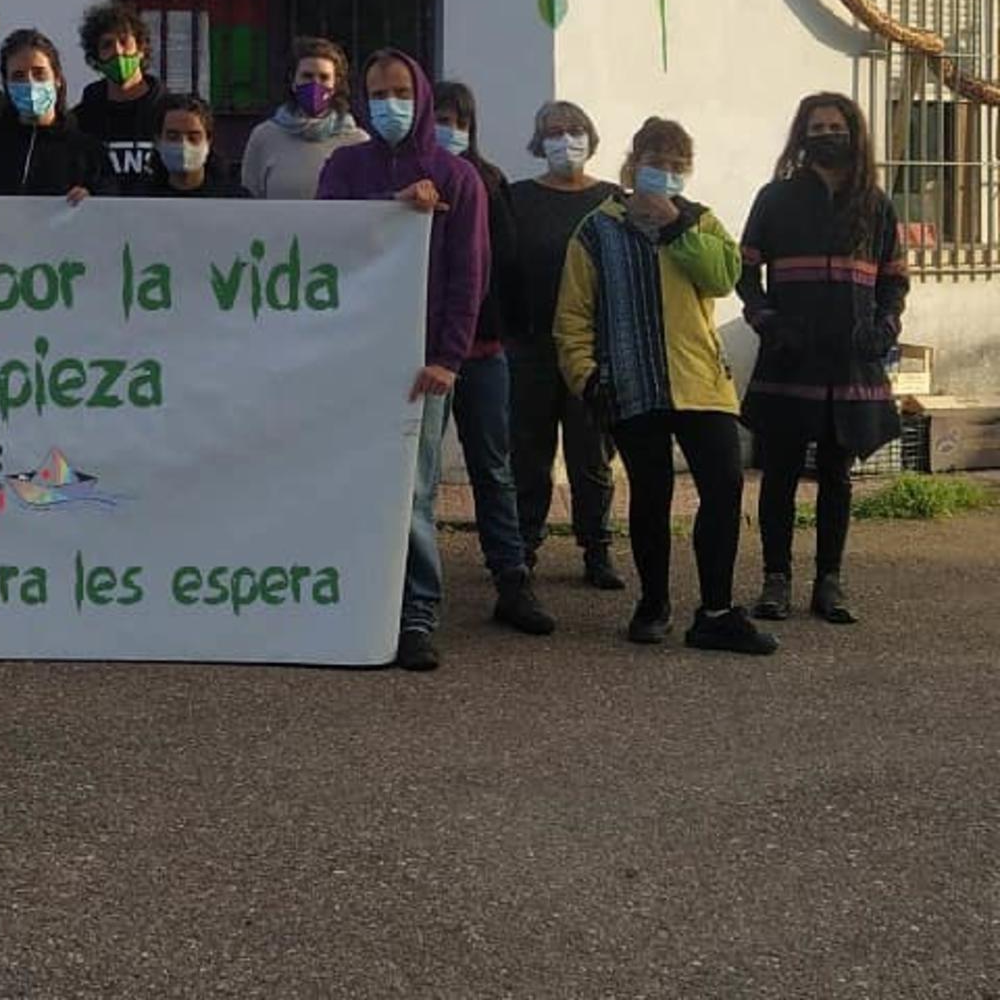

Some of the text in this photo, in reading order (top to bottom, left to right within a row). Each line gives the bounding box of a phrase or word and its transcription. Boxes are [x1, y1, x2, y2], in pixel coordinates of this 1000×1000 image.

[122, 241, 172, 319] la
[210, 237, 341, 319] vida
[74, 551, 144, 611] les
[172, 562, 341, 616] espera
